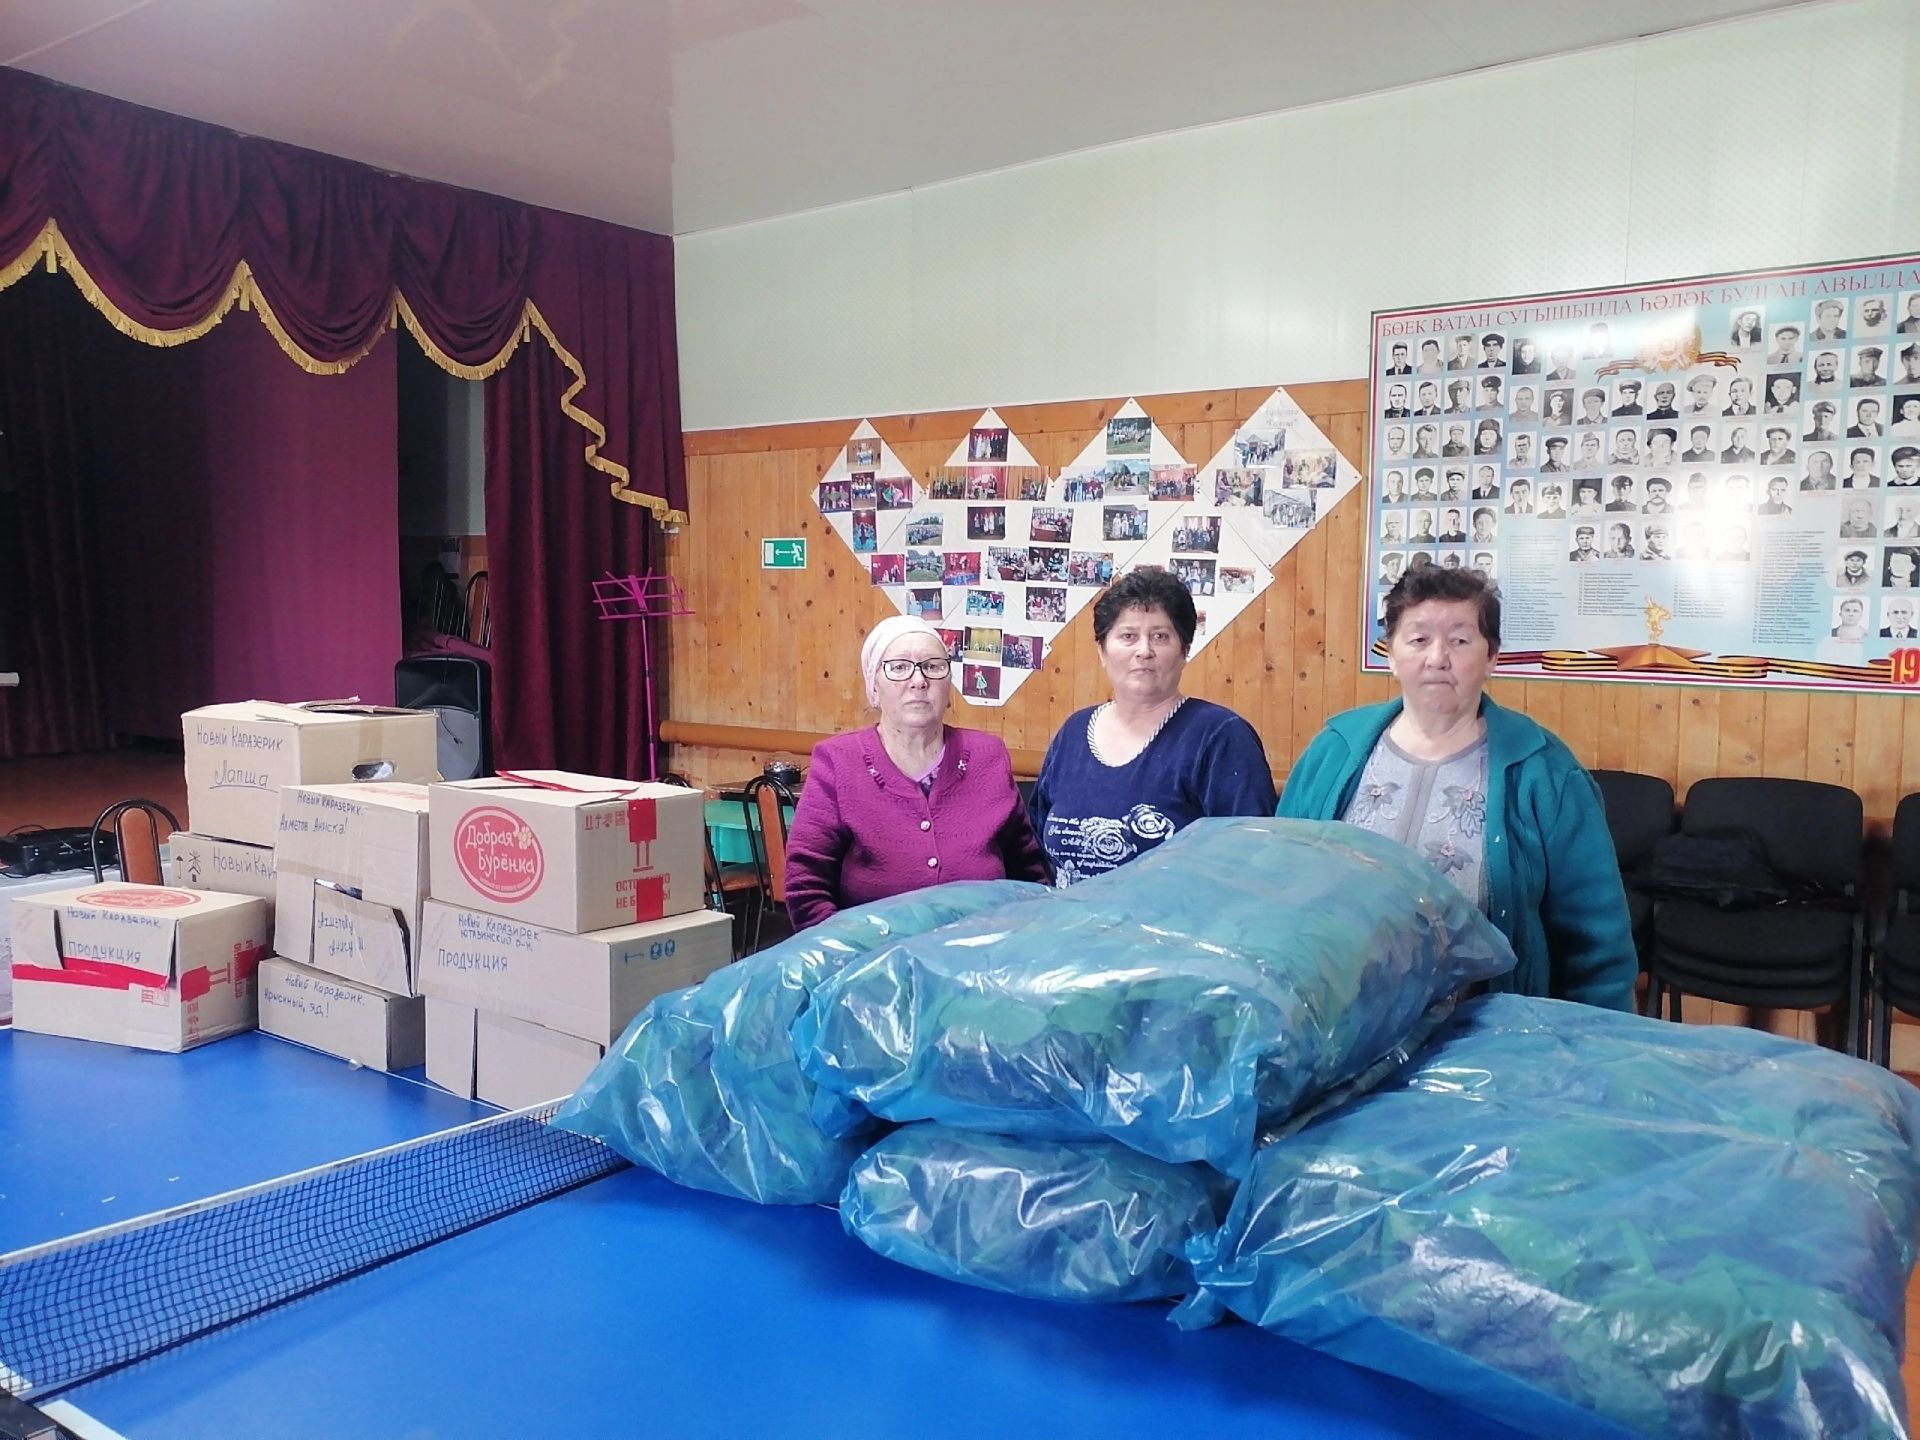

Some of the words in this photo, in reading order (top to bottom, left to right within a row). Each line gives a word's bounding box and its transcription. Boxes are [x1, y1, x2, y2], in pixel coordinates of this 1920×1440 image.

[1382, 319, 1428, 337] БӨЕК
[1432, 313, 1491, 332] ВАТАН
[1497, 299, 1633, 326] СУГЫШЫНДА
[1640, 289, 1715, 311] ҺӘЛӘК
[1889, 648, 1920, 684] 19
[214, 760, 269, 787] Лапша
[465, 822, 514, 855] Добрая
[478, 848, 535, 880] Бурёнка
[438, 948, 509, 973] ПРОДУКЦИЯ
